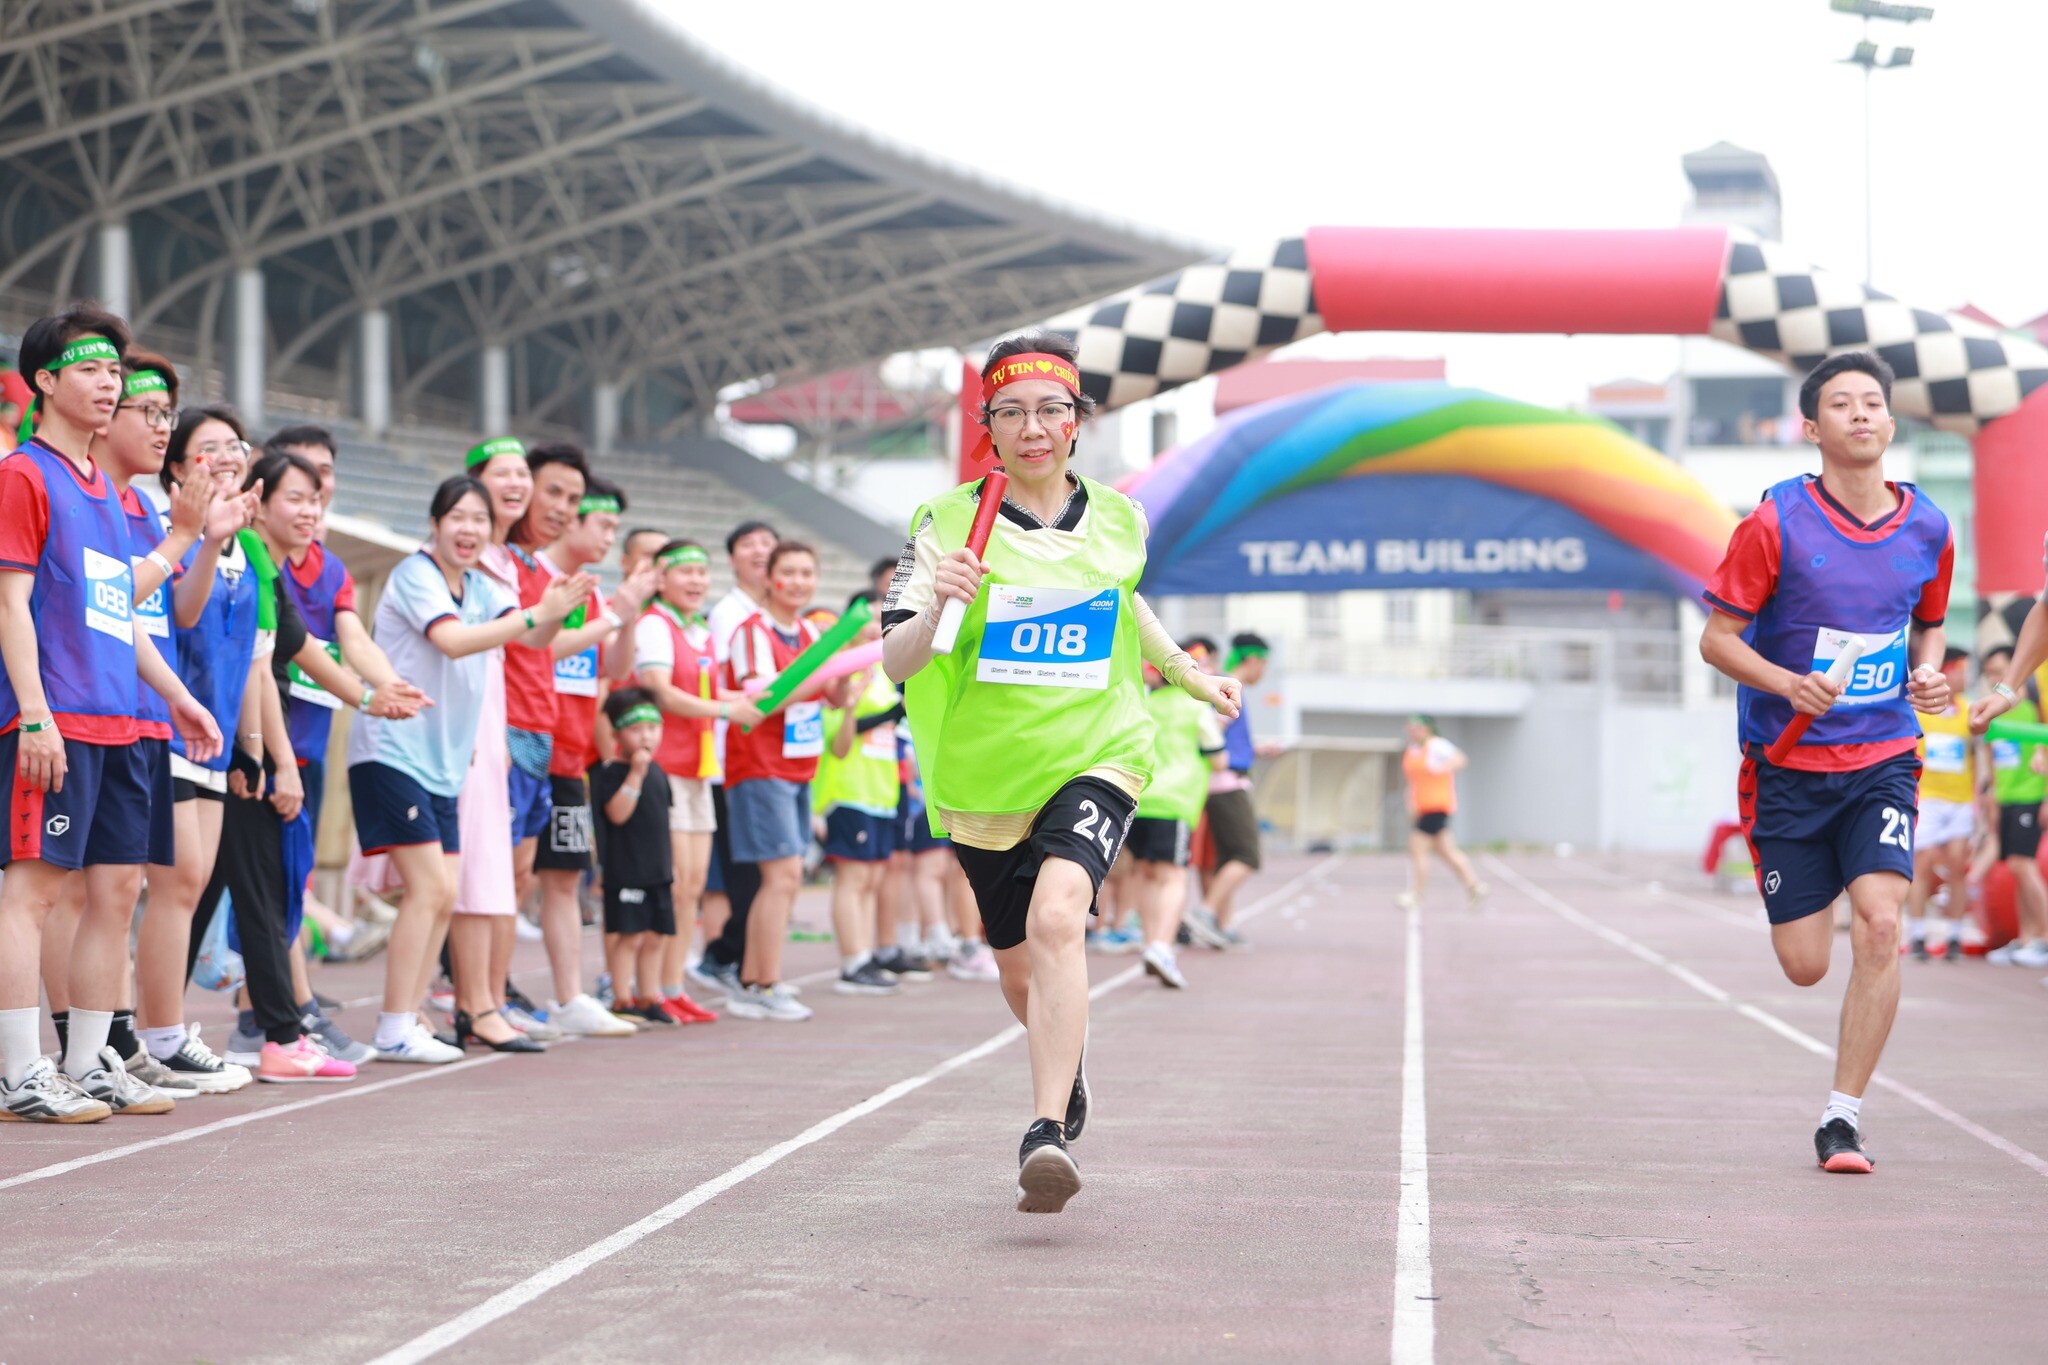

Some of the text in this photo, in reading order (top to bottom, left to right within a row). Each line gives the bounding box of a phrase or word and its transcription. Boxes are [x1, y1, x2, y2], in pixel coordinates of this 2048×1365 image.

[77, 343, 97, 356] TIN
[991, 365, 1005, 385] TỰ
[1008, 362, 1034, 376] TIN
[1241, 538, 1588, 575] TEAM BUILDING
[95, 580, 128, 618] 033
[137, 588, 163, 614] 32
[1010, 622, 1088, 657] 018
[1073, 799, 1114, 862] 24
[1879, 806, 1910, 852] 23
